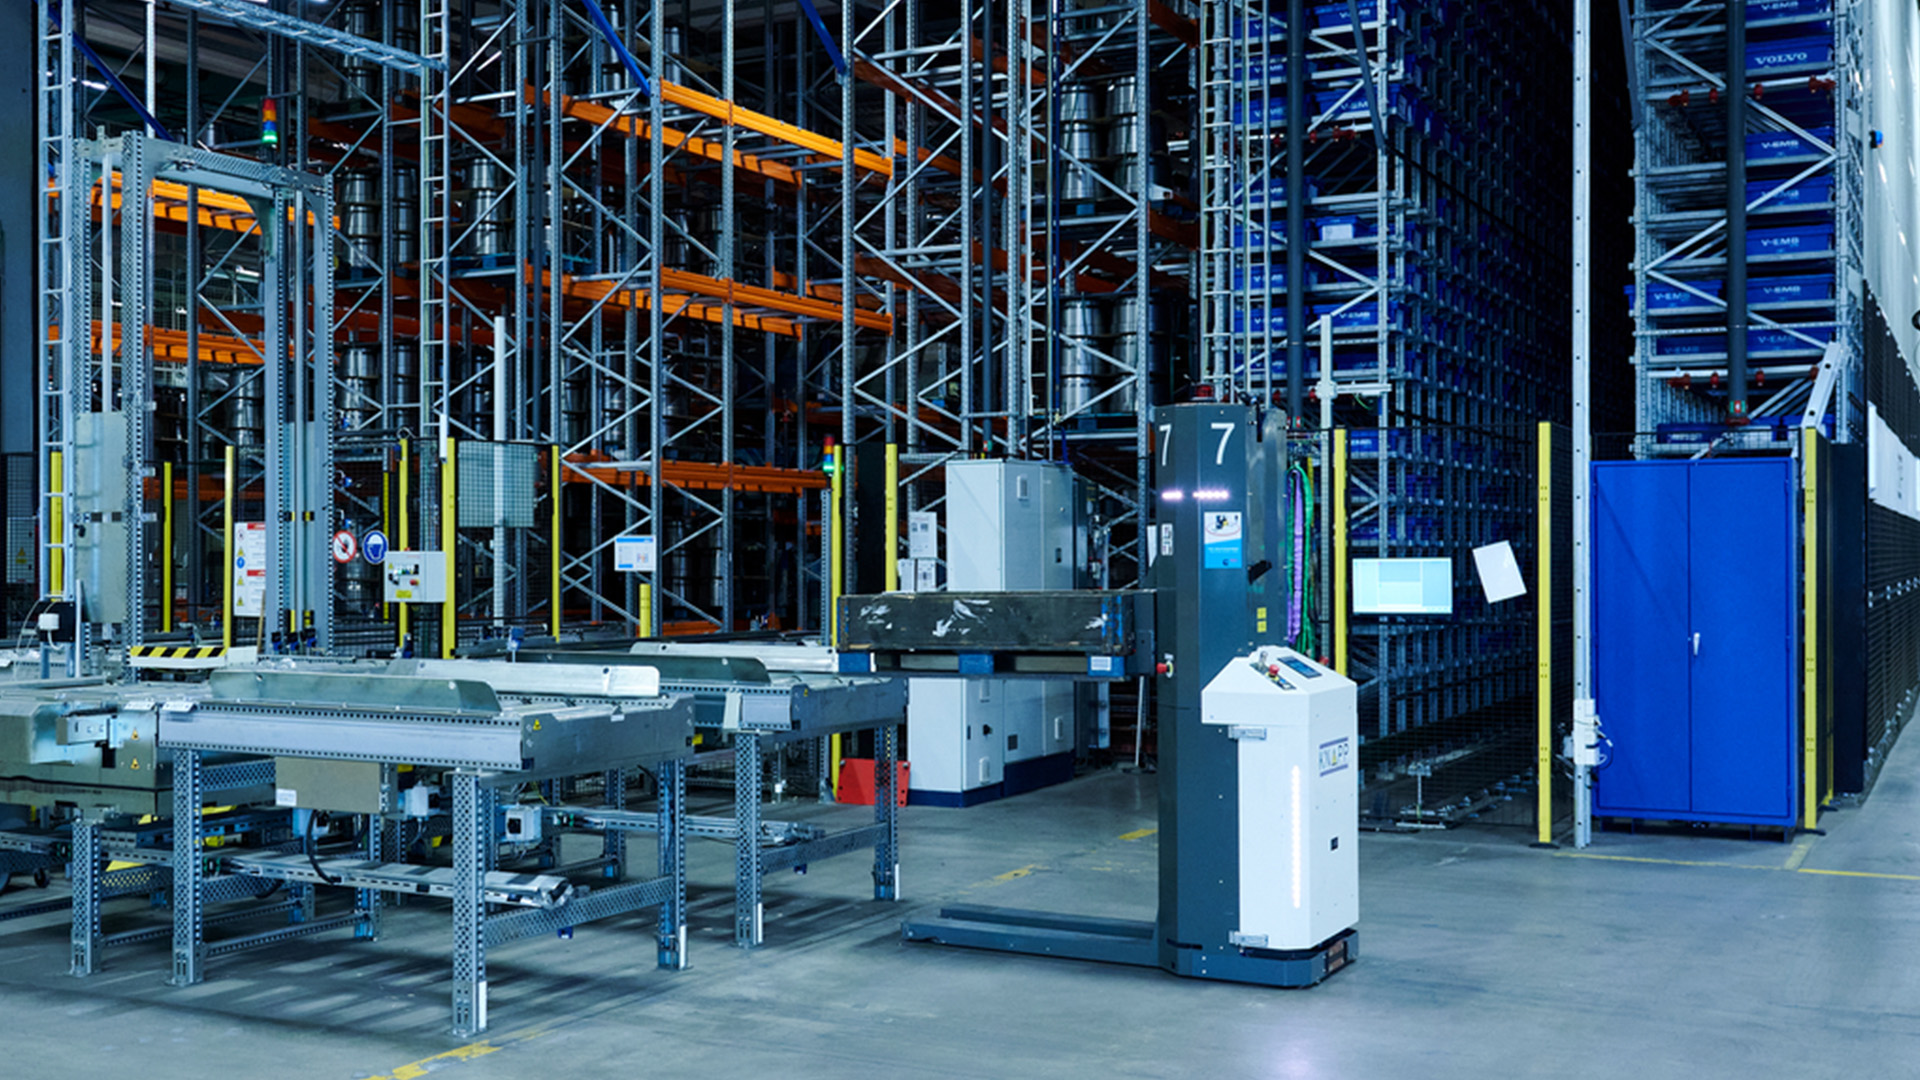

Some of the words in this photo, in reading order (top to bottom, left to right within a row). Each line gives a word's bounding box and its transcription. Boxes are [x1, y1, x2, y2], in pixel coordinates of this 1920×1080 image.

[1755, 52, 1807, 64] VOLVO
[1159, 423, 1171, 466] 7
[1211, 422, 1235, 465] 7
[1319, 743, 1349, 769] KNAPP
